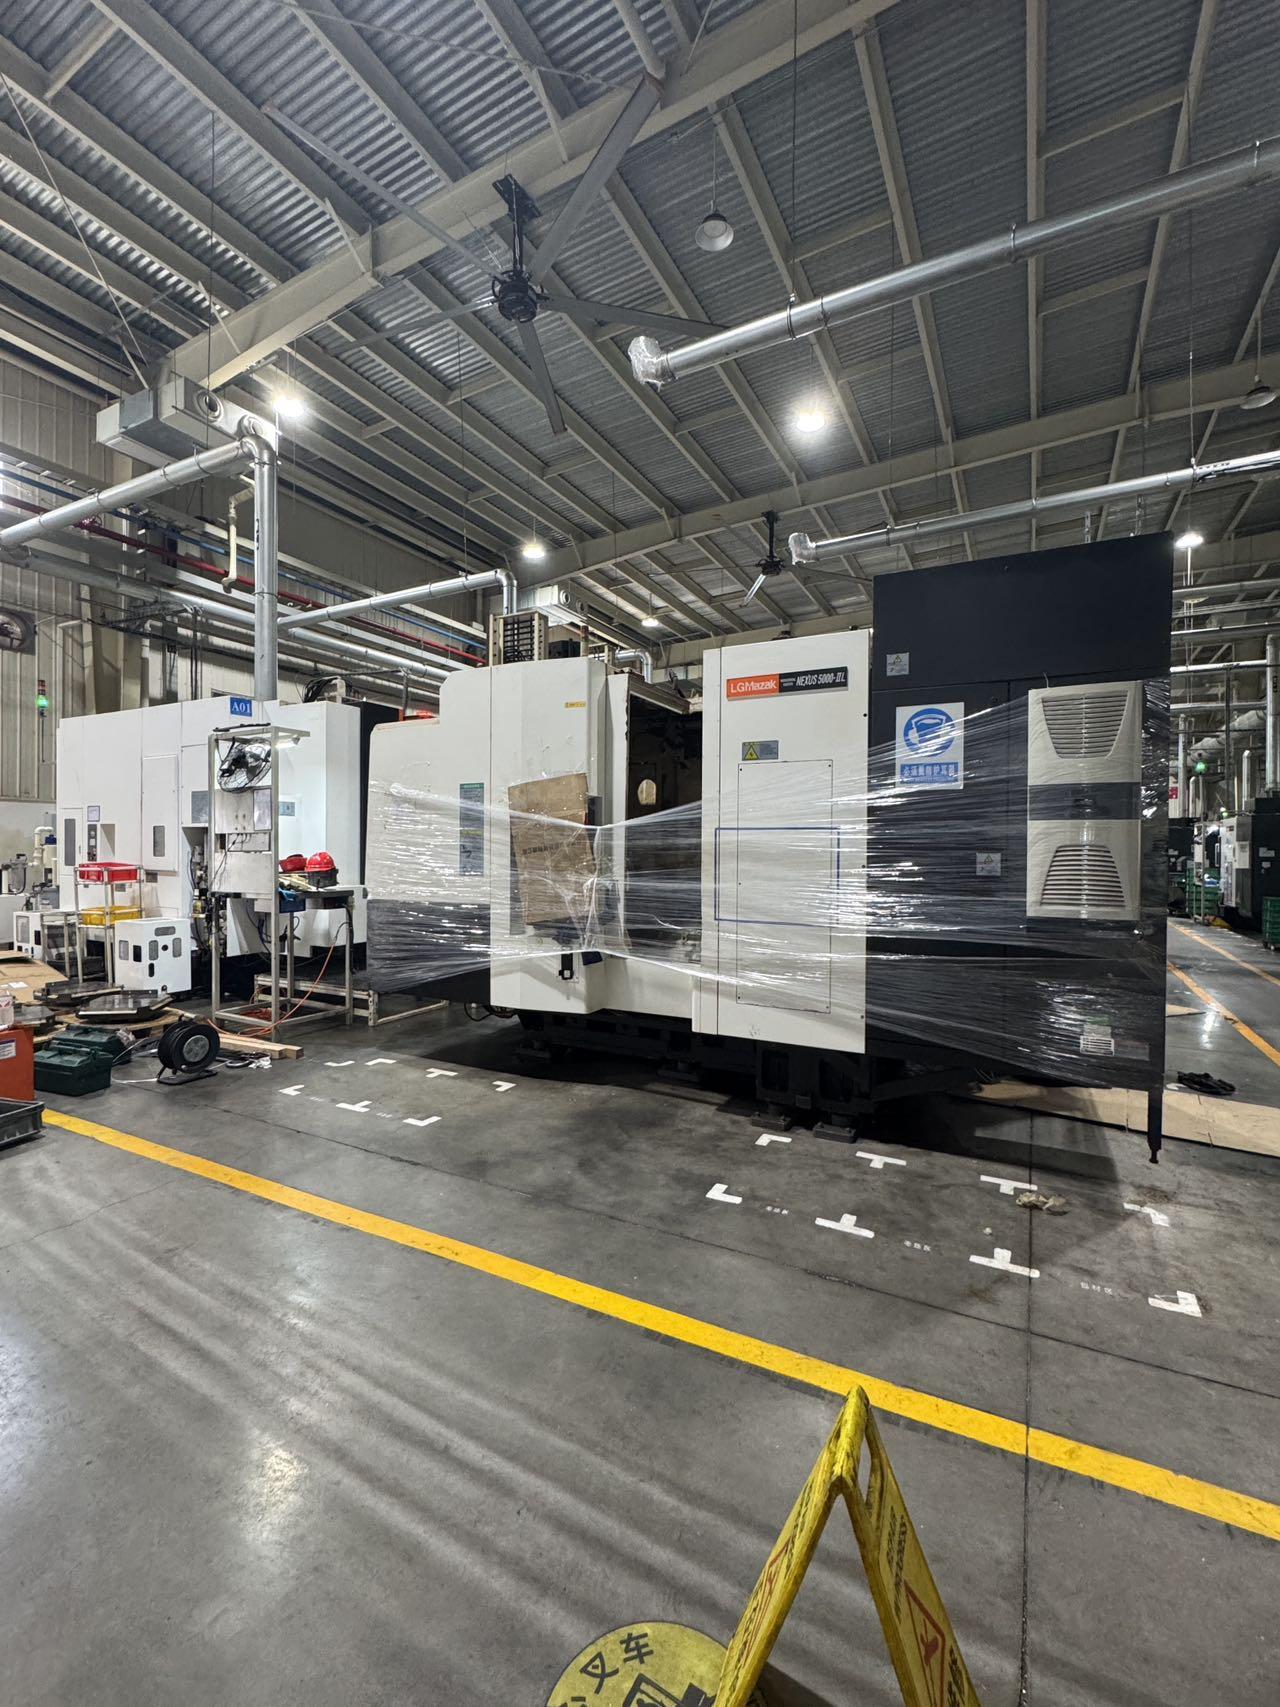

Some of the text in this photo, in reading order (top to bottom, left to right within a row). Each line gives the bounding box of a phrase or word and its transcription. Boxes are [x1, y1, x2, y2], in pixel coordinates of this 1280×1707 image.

[730, 680, 777, 693] LGMazak
[796, 674, 817, 687] NEXUS
[231, 701, 251, 713] A01
